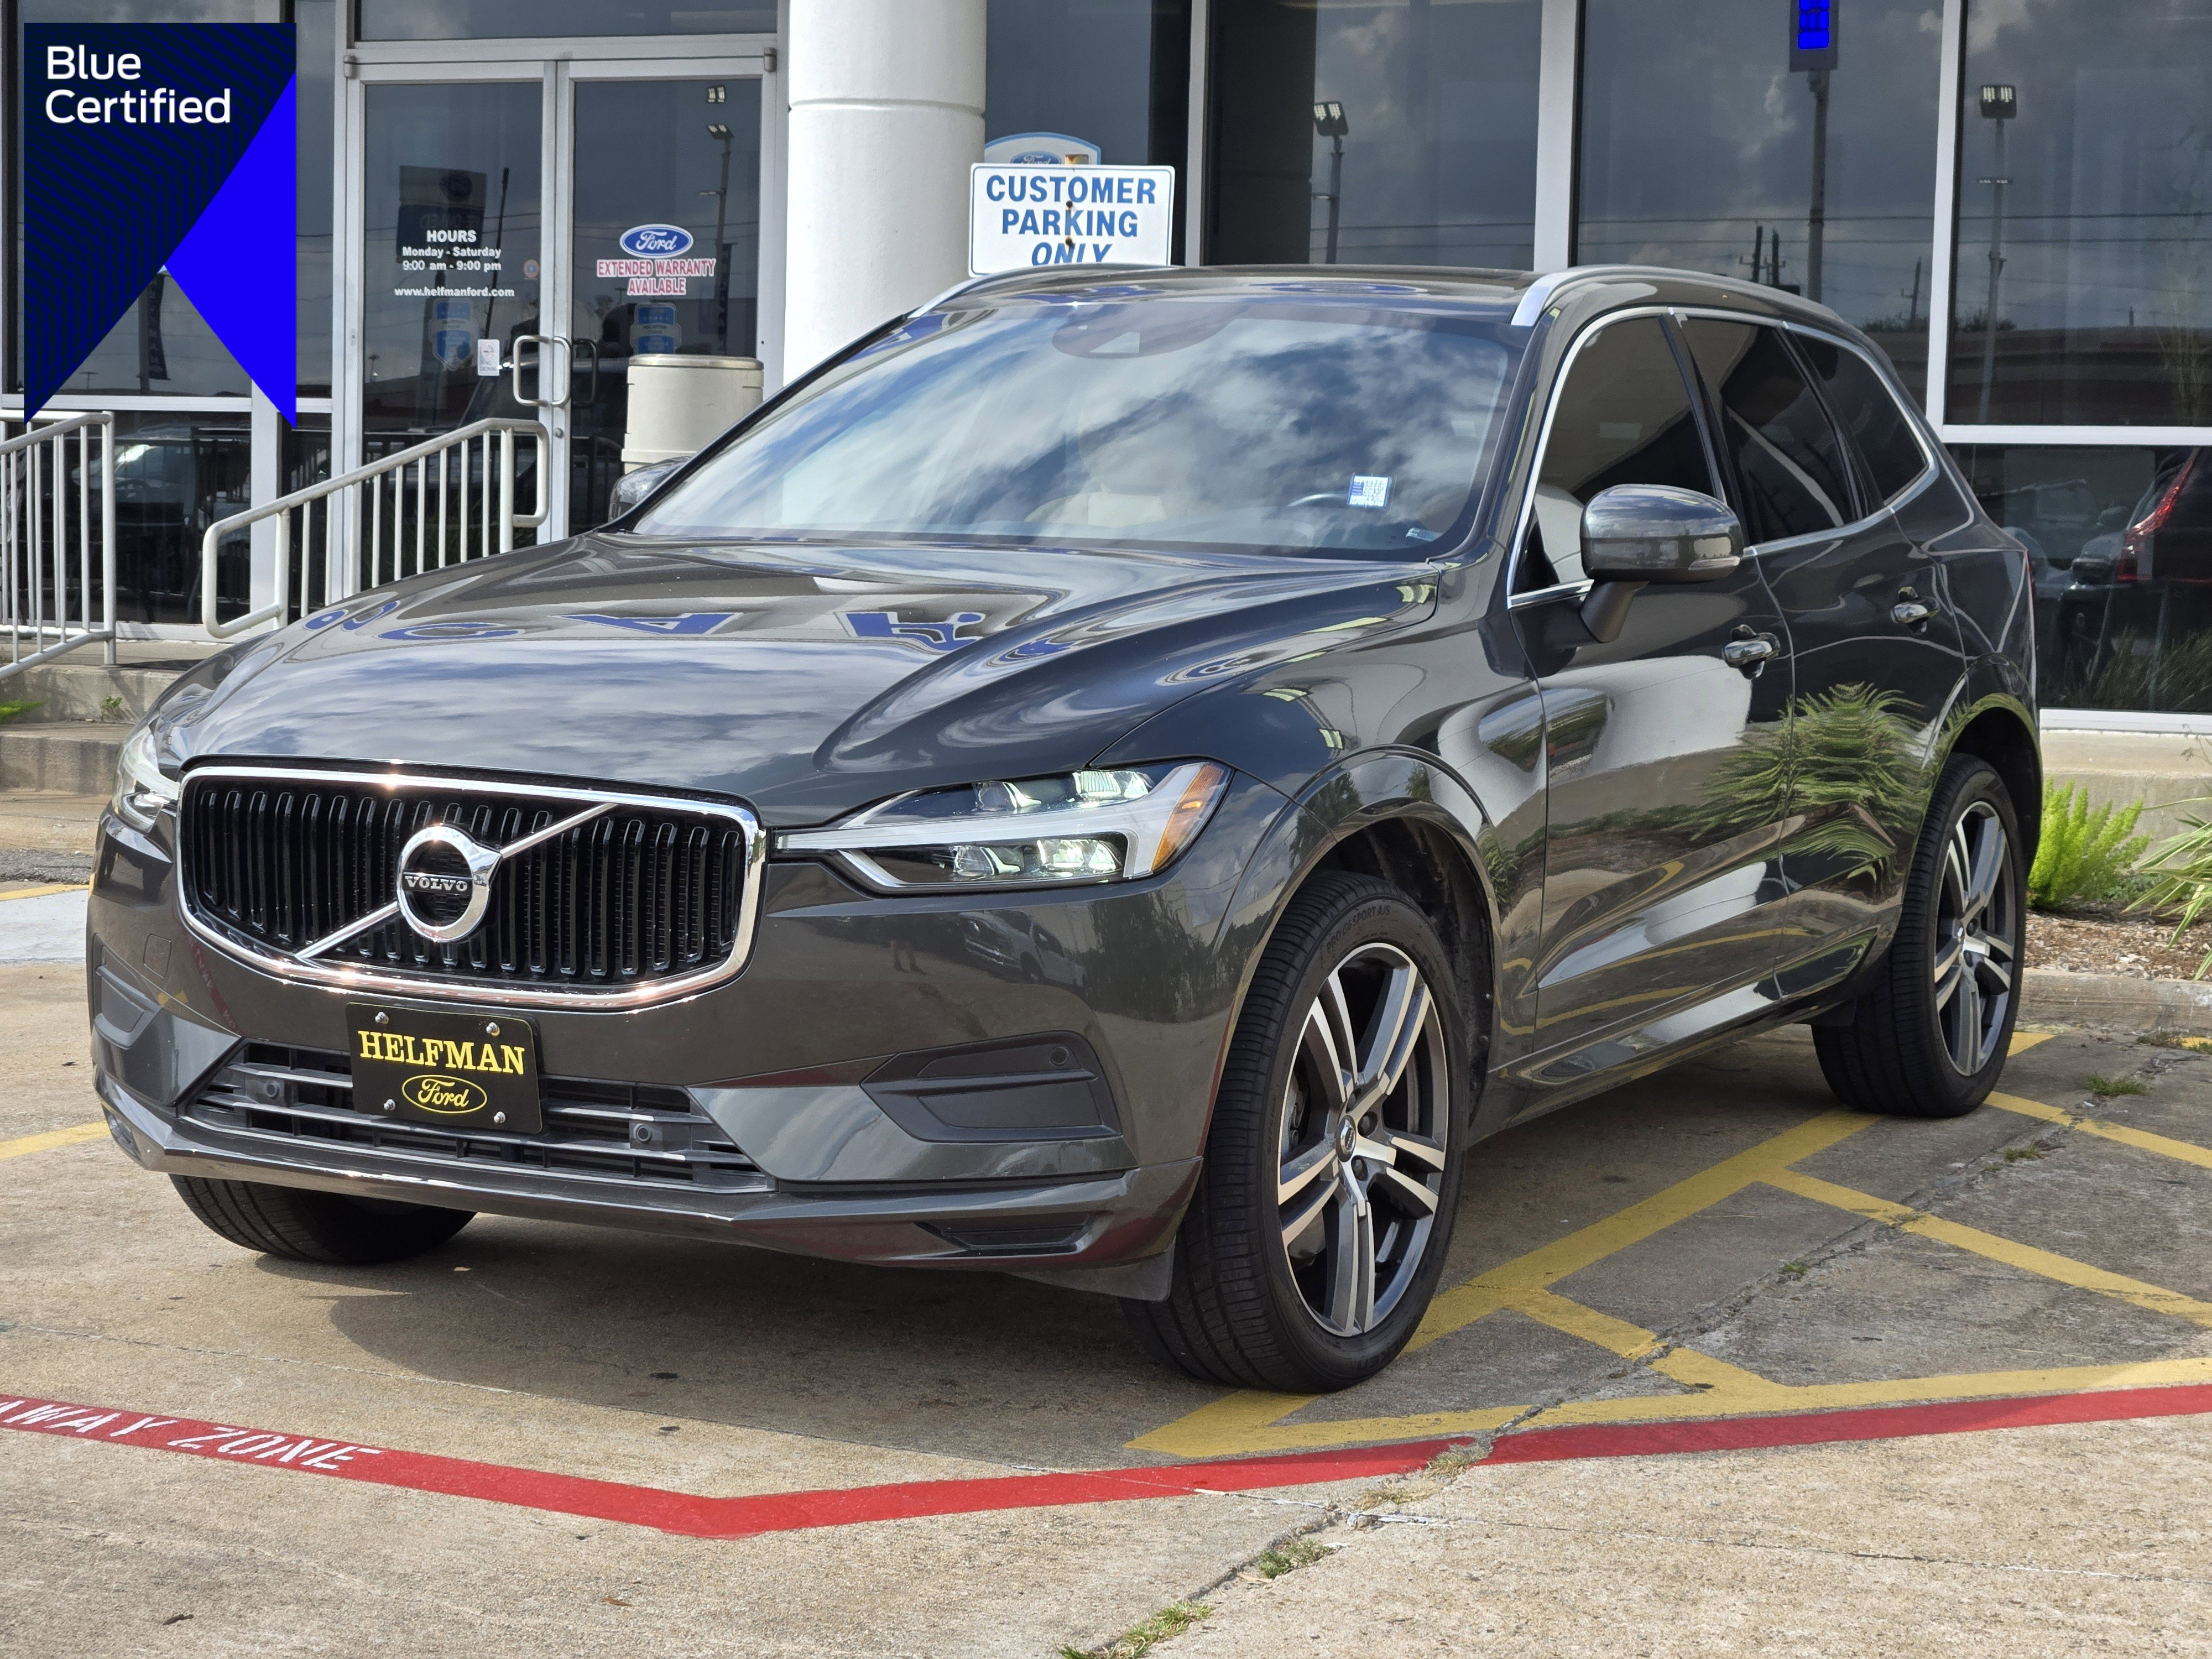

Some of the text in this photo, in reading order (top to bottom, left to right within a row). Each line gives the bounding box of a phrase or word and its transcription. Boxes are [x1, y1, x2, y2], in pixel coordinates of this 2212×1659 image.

[987, 175, 1156, 204] CUSTOMER
[1001, 208, 1138, 237] PARKING
[426, 229, 477, 242] HOURS
[636, 231, 677, 251] Ford
[402, 246, 444, 259] Monday
[453, 246, 502, 259] Saturday
[402, 260, 425, 270] 9:00
[429, 262, 447, 270] am
[456, 260, 481, 270] 9:00
[483, 262, 502, 272] pm
[598, 259, 716, 276] EXTENDED WARRANTY
[394, 286, 515, 296] www.helfmanford.com
[628, 279, 686, 294] AVAILABLE
[405, 876, 468, 891] VOLVO
[1352, 905, 1376, 927] SPORT
[358, 1030, 525, 1074] HELFMAN
[418, 1078, 469, 1107] Ford
[167, 1427, 383, 1469] ZONE
